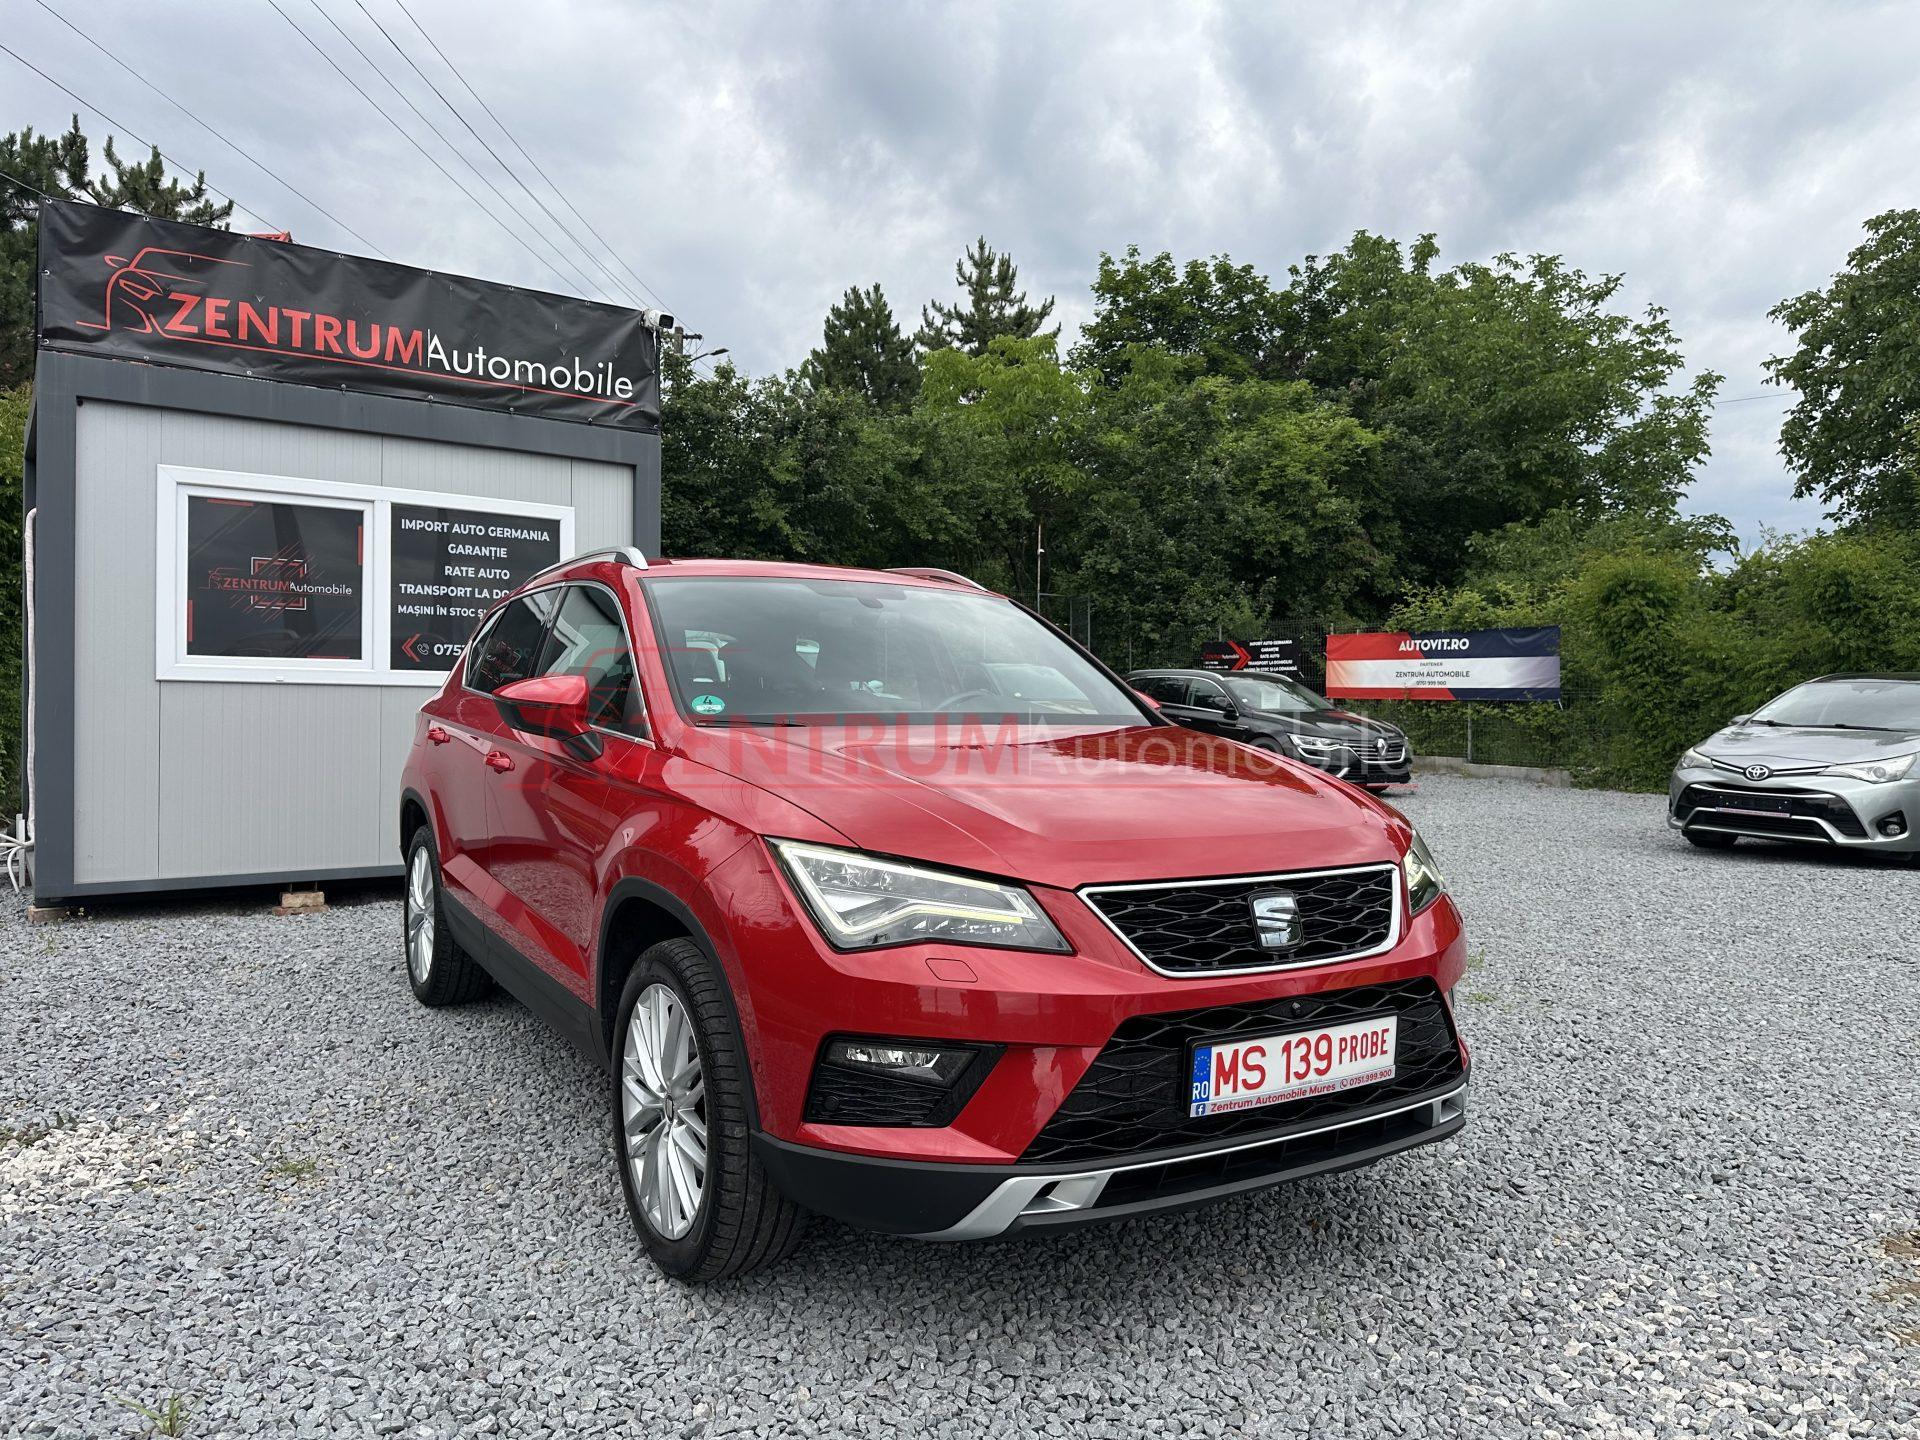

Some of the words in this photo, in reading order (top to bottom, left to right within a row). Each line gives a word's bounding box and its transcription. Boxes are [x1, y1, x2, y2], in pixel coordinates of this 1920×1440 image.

[165, 293, 423, 366] ZENTRUM
[427, 331, 634, 399] Automobile
[401, 518, 449, 533] IMPORT
[452, 523, 485, 536] AUTO
[488, 526, 550, 542] GERMANIA
[447, 543, 508, 560] GARANȚIE
[444, 565, 475, 578] RATE
[478, 568, 510, 580] AUTO
[223, 577, 290, 591] ZENTRUM
[290, 581, 352, 595] Automobile
[399, 583, 472, 598] TRANSPORT
[475, 588, 490, 599] LA
[397, 604, 434, 617] MAȘINI
[436, 604, 447, 616] ÎN
[449, 607, 475, 617] STOC
[1398, 638, 1469, 651] AUTOVIT.RO
[1426, 670, 1470, 678] AUTOMOBILE
[1193, 1081, 1209, 1100] RO
[1214, 1045, 1267, 1096] MS
[1281, 1033, 1333, 1084] 139
[1338, 1028, 1390, 1065] PROBE
[1210, 1099, 1253, 1113] Zentrum
[1255, 1088, 1307, 1105] Automobile
[1309, 1082, 1336, 1096] Mures
[1349, 1069, 1392, 1087] 0751.999.900
